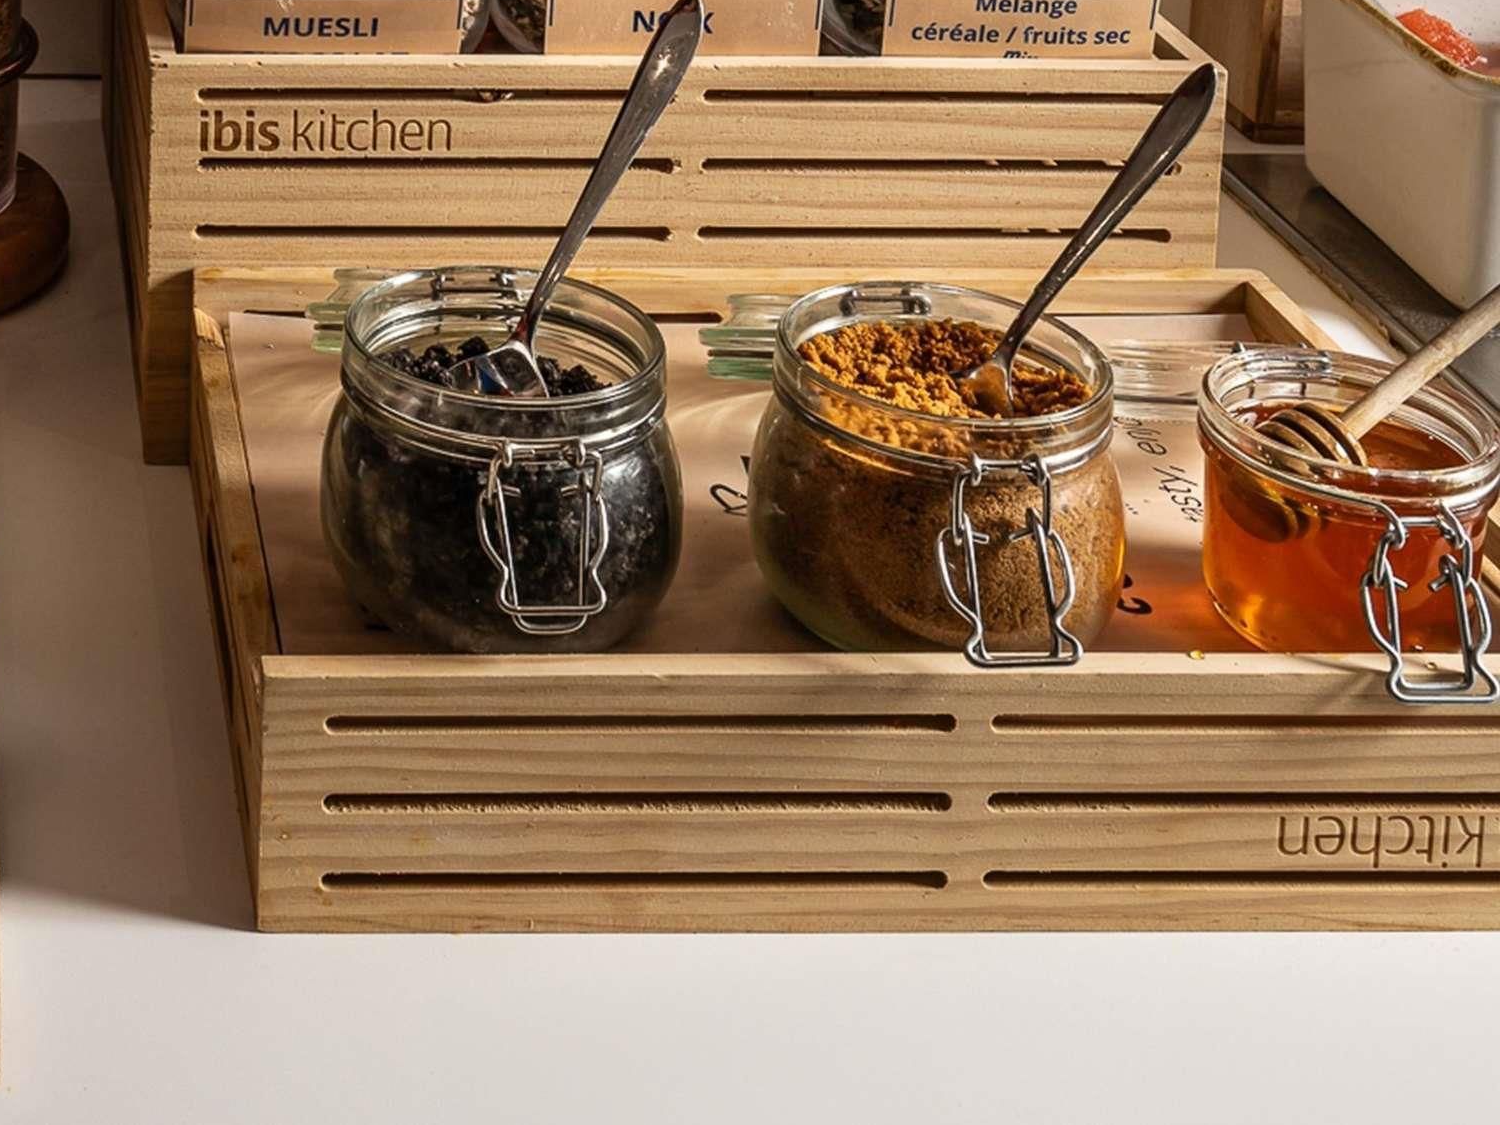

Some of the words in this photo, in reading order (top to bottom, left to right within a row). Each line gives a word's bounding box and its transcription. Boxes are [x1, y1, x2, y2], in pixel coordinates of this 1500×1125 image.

[263, 17, 379, 37] MUESLI
[911, 23, 1000, 43] céréale
[1023, 26, 1088, 45] fruits
[1093, 29, 1131, 44] sec
[200, 109, 281, 152] ibis
[292, 109, 453, 152] kitchen
[1276, 815, 1486, 869] kitchen
